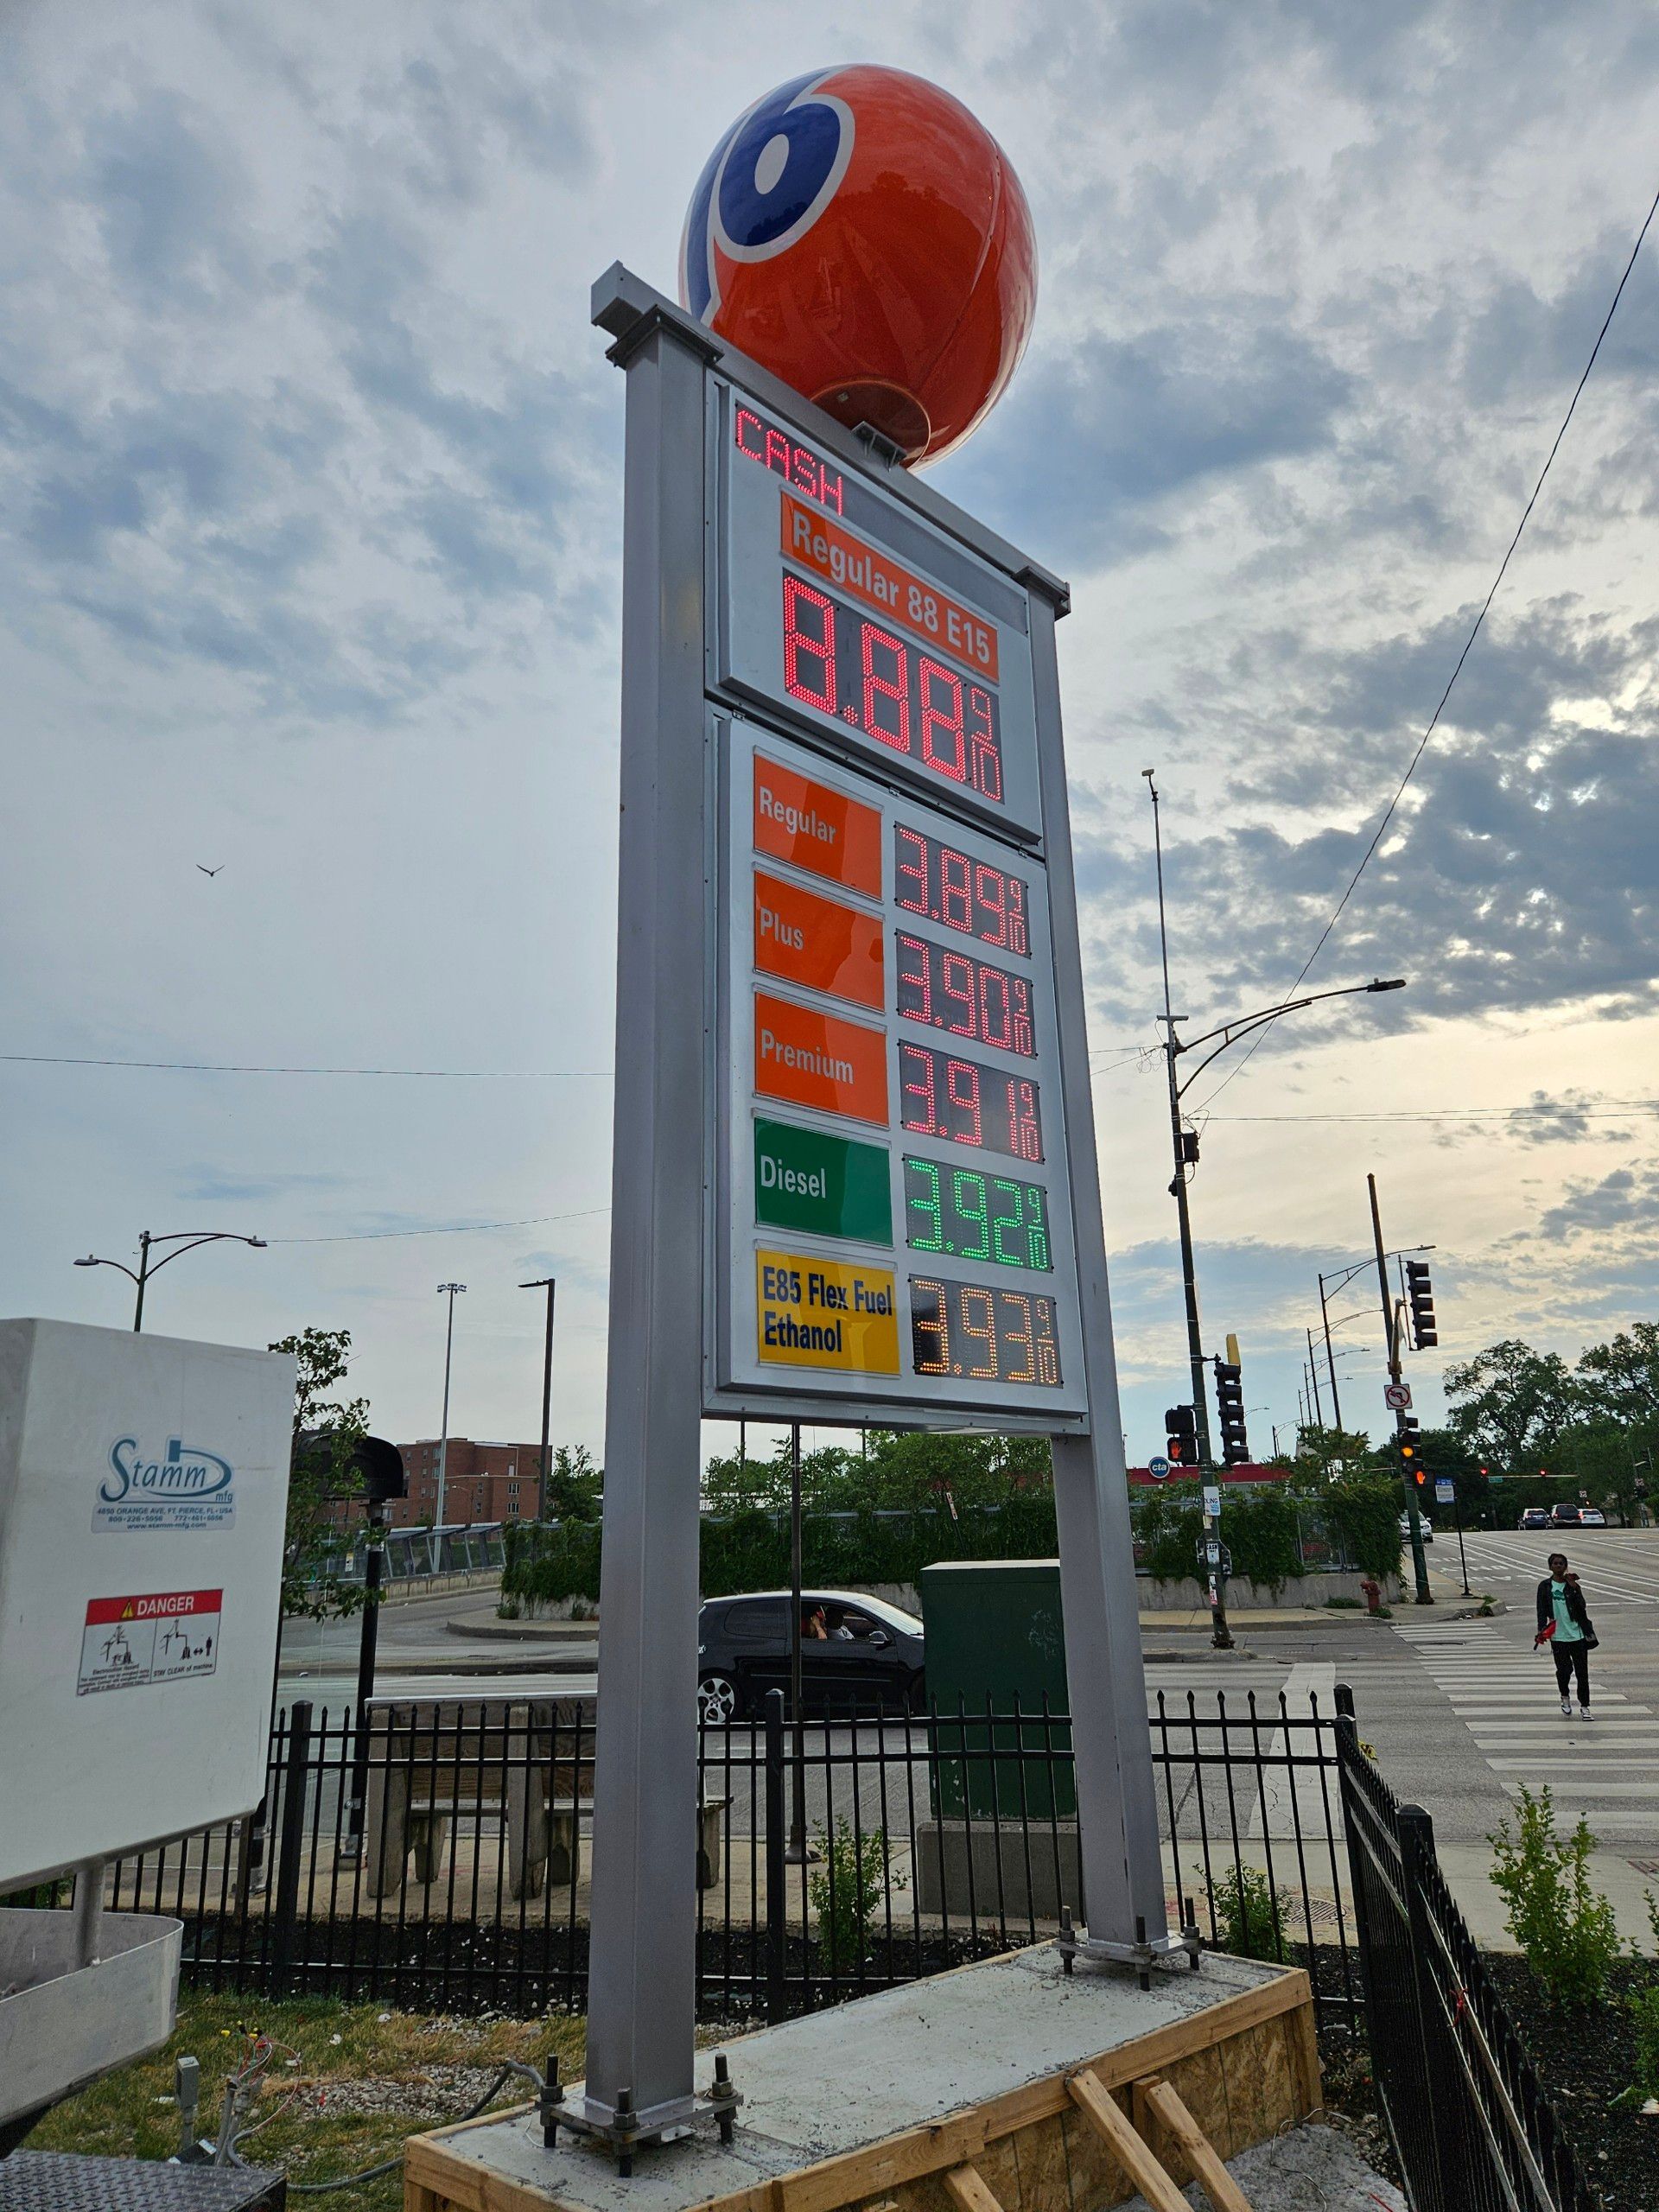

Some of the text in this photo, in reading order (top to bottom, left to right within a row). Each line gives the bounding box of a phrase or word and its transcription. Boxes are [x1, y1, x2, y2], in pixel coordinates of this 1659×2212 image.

[735, 409, 843, 517] CASH
[793, 511, 991, 664] Regular 88 E15
[759, 785, 836, 844] Regular
[899, 827, 1007, 948] 3.89
[759, 906, 804, 951] Plus
[899, 936, 1011, 1050] 3.90
[760, 1029, 855, 1085] Premium
[904, 1044, 1019, 1160] 3.91
[760, 1155, 826, 1199] Diesel
[907, 1159, 1024, 1265] 3.92
[763, 1266, 893, 1317] E85 Flex Fuel
[764, 1311, 842, 1353] Ethanol
[914, 1279, 1035, 1383] 3.93
[100, 1439, 207, 1502] Stamm
[216, 1490, 233, 1503] mfg
[1152, 1463, 1167, 1471] cta
[137, 1596, 194, 1616] DANGER
